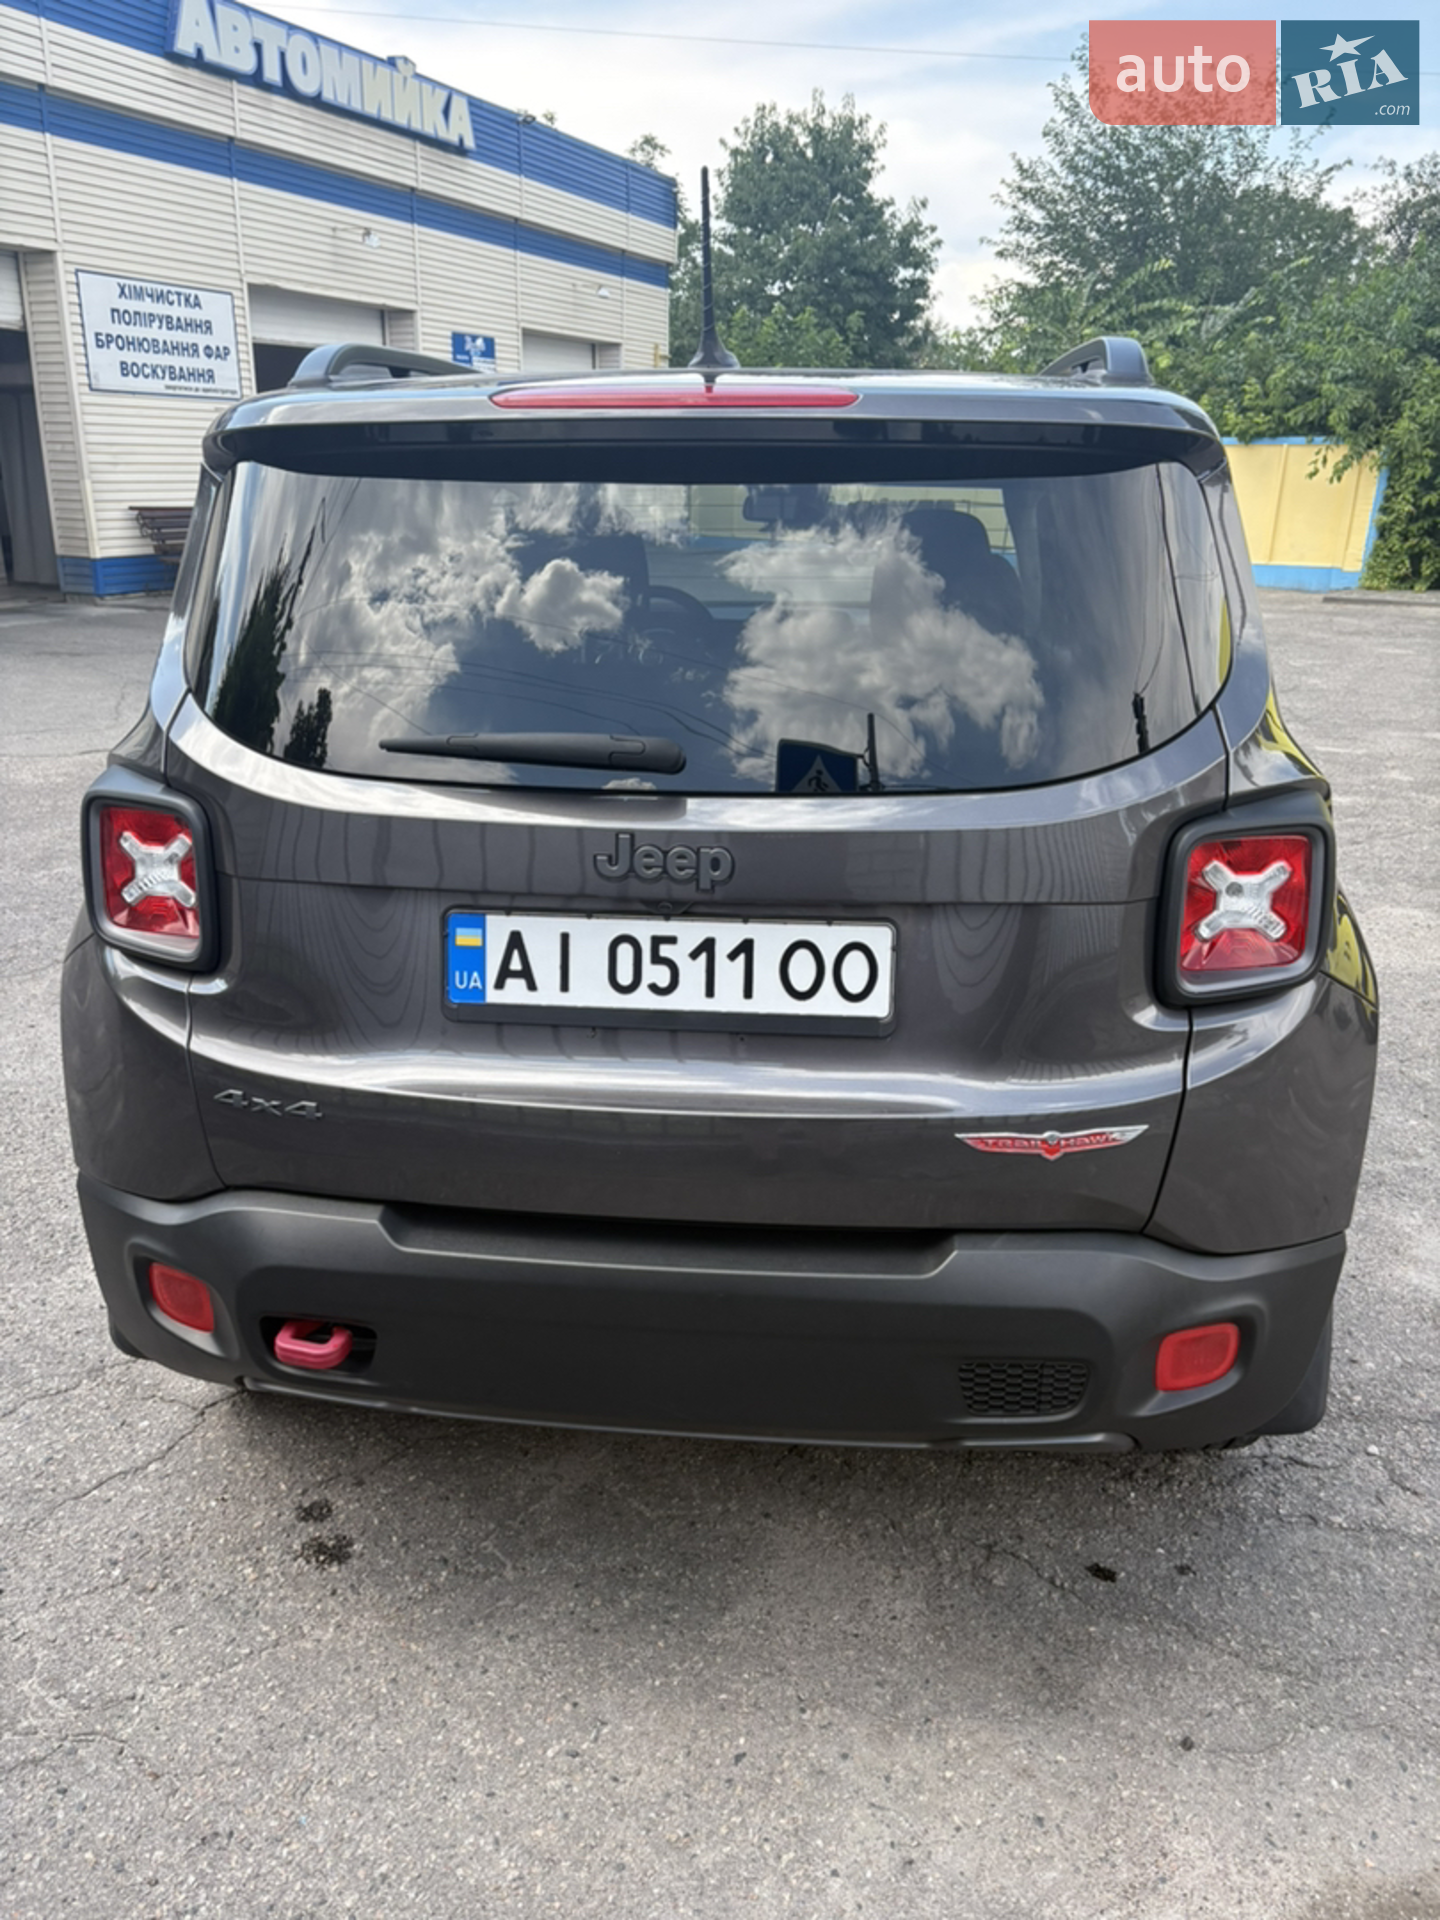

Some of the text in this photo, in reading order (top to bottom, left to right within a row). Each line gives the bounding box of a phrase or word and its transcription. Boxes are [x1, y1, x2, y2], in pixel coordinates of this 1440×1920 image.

[174, 0, 476, 149] АВТОМИЙКА
[117, 282, 203, 310] ХІМЧИСТКА
[110, 307, 213, 335] ПОЛІРУВАННЯ
[94, 332, 231, 361] БРОНЮВАННЯ ФАР
[119, 360, 215, 384] ВОСКУВАННЯ
[594, 833, 735, 893] Jeep
[607, 933, 755, 999] 0511
[454, 971, 483, 990] UA
